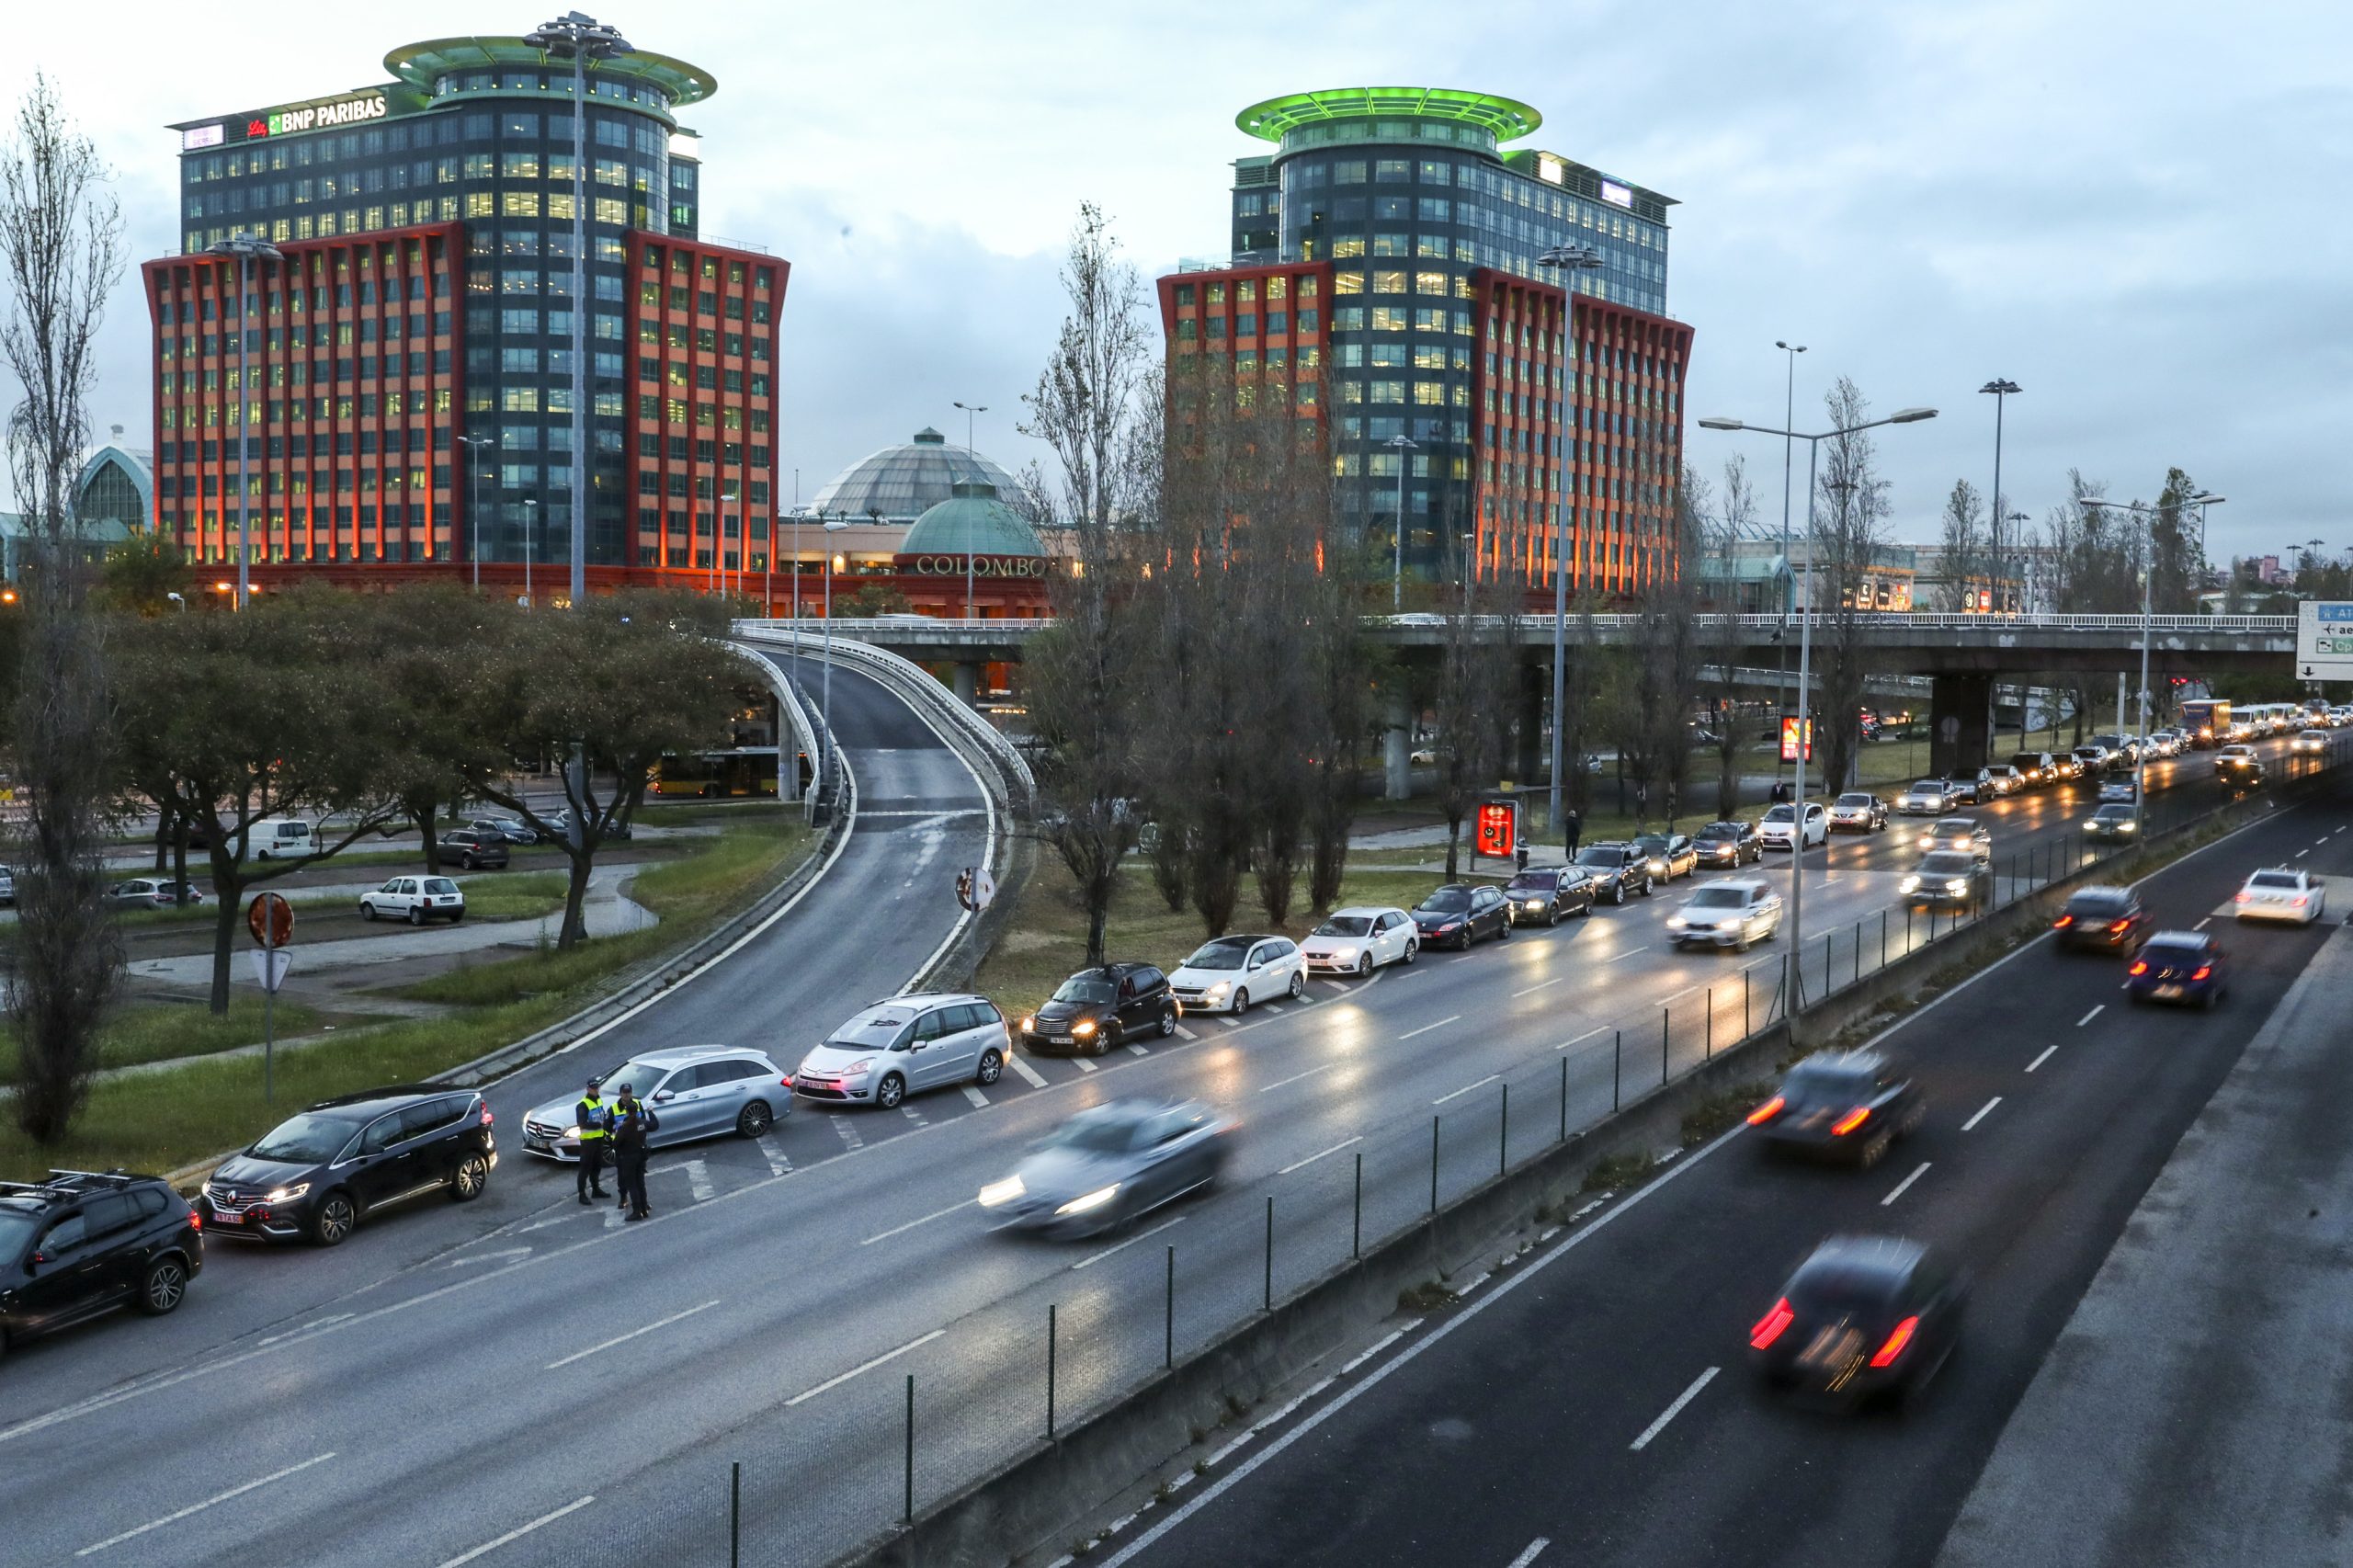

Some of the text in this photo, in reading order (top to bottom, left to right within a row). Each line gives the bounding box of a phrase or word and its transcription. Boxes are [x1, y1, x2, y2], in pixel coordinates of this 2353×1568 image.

[281, 97, 386, 132] BNP PARIBAS
[916, 555, 1046, 578] COLOMBO
